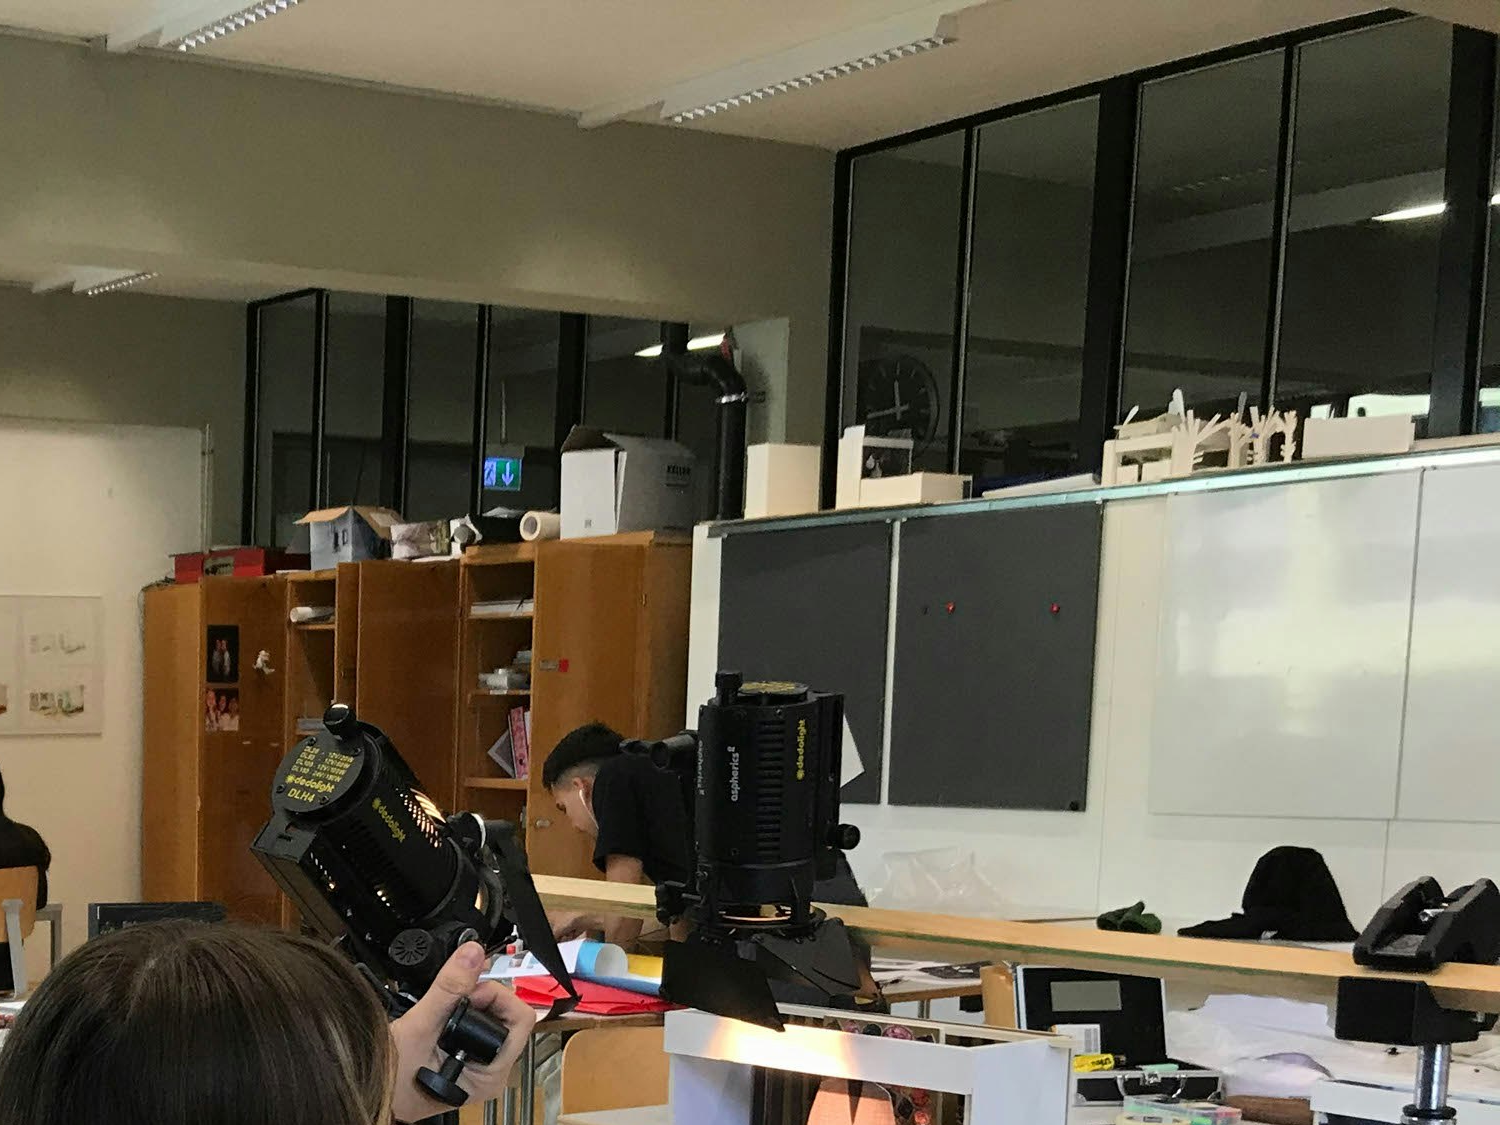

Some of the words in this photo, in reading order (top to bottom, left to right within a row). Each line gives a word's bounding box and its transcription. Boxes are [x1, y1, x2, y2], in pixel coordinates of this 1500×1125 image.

[796, 719, 807, 770] dedolight
[287, 788, 316, 803] DLH4
[294, 775, 336, 793] dedolight
[378, 804, 407, 844] dedolight
